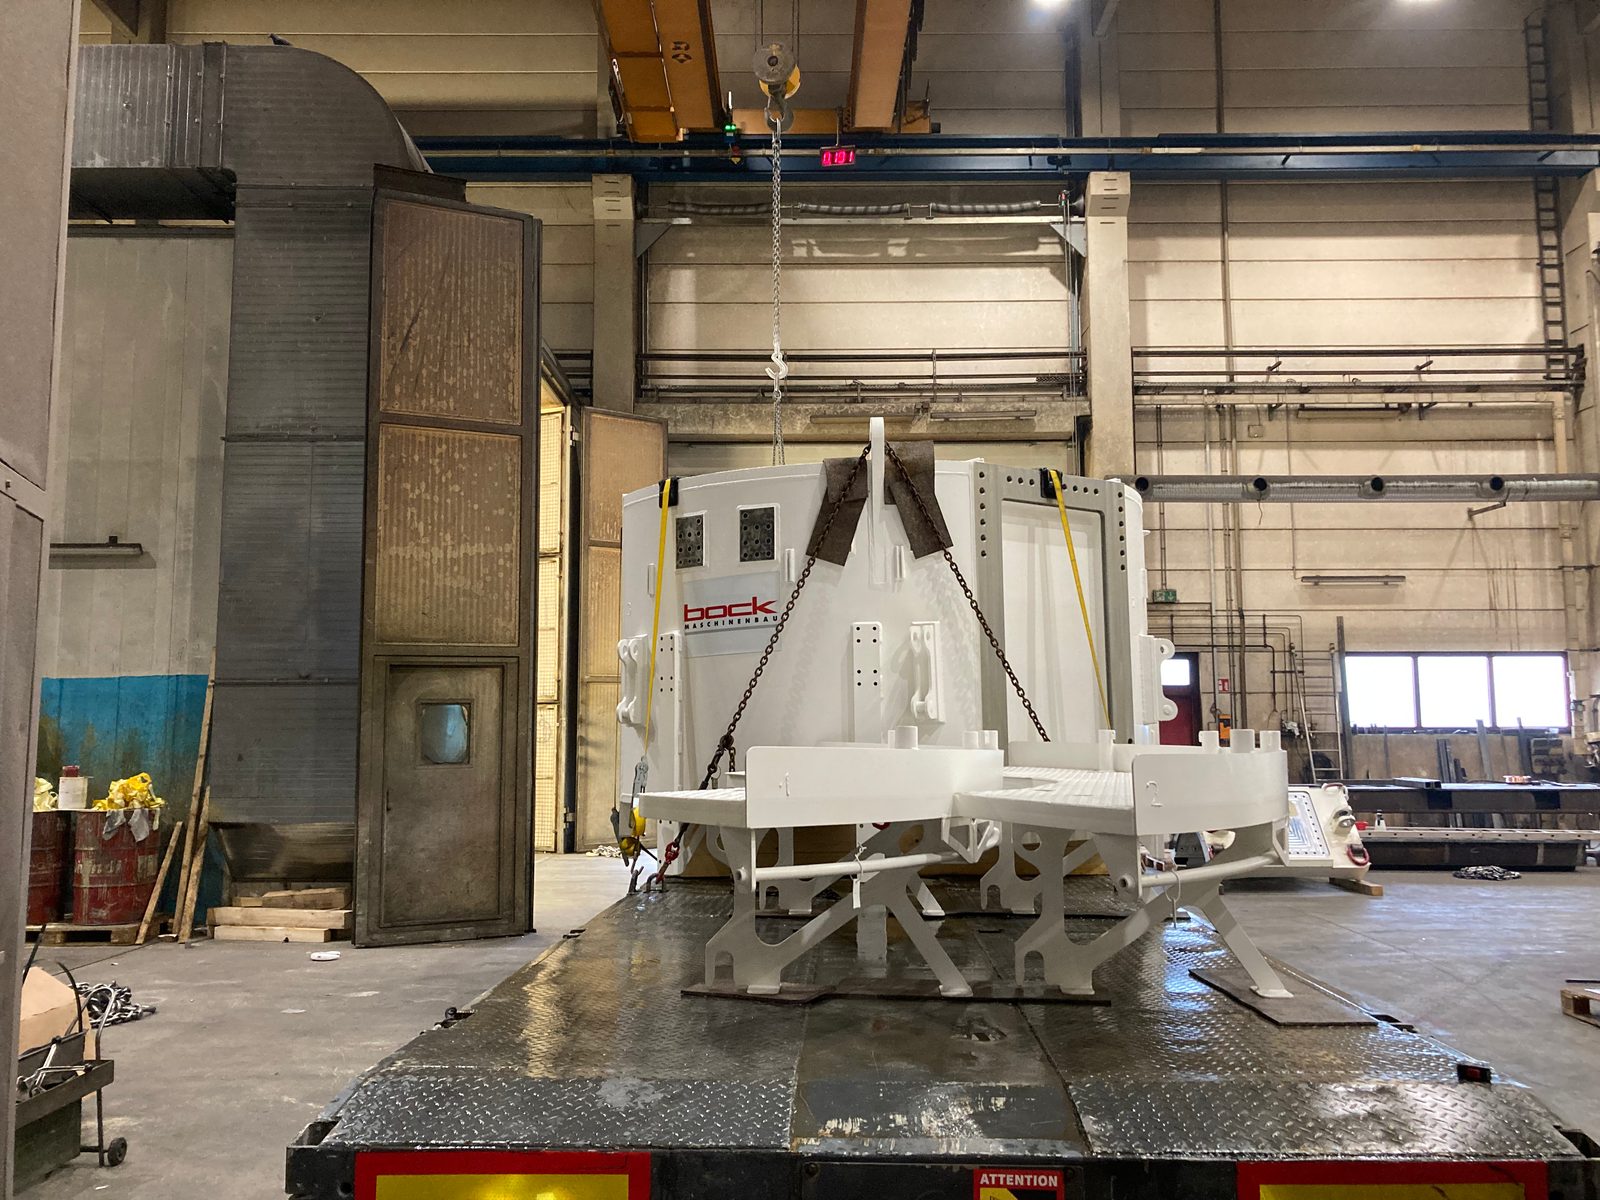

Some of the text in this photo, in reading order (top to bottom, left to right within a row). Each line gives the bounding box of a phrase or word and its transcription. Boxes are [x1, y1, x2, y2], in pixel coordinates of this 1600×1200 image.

[684, 596, 777, 622] bock
[684, 615, 778, 630] MASCHINENBAU
[1146, 780, 1163, 808] 2
[980, 1173, 1058, 1187] ATTENTION
